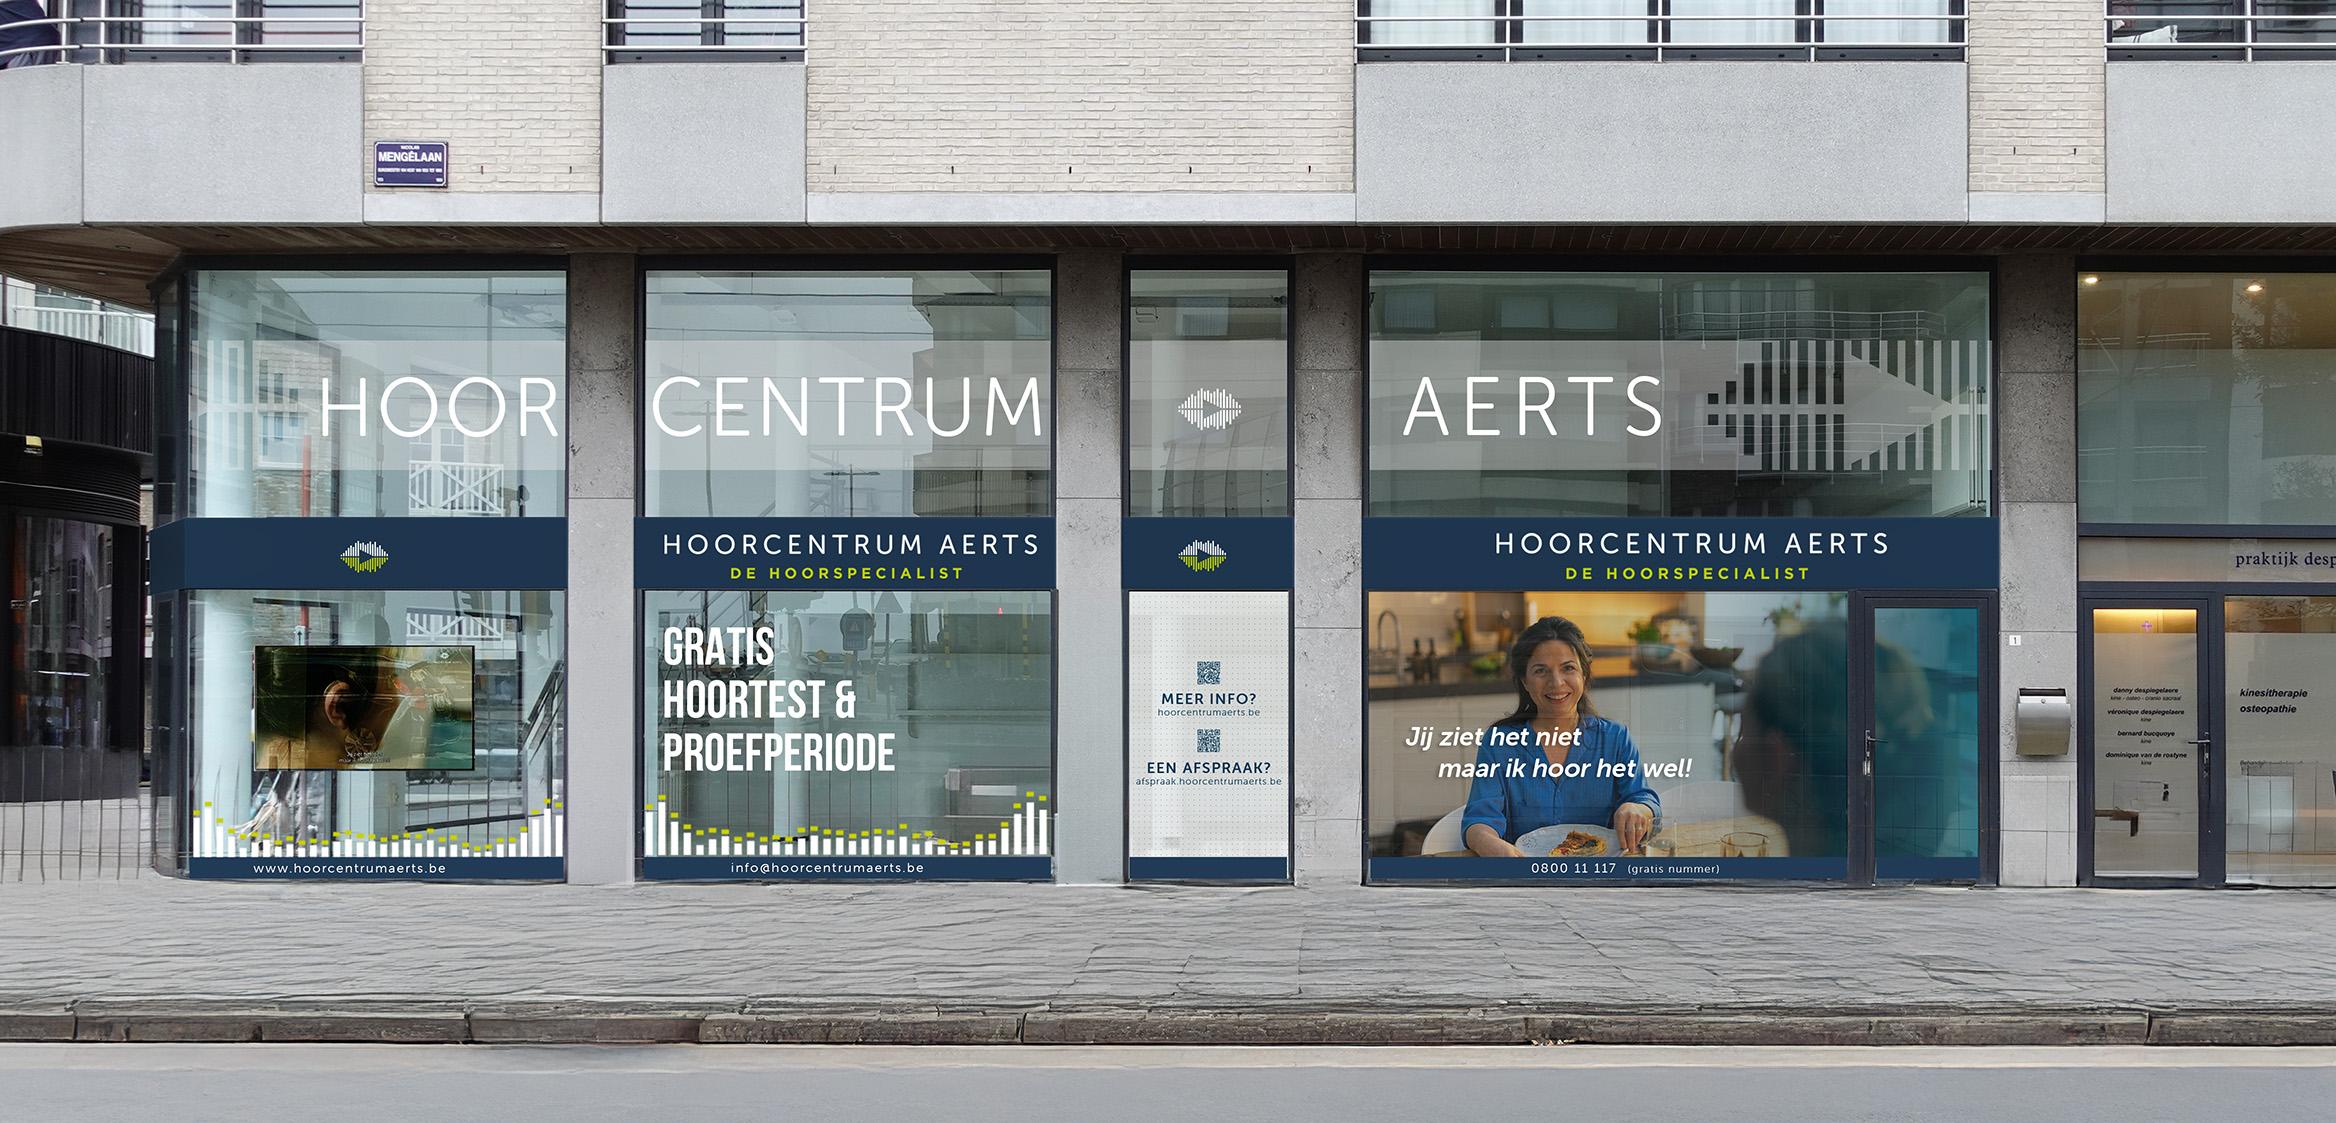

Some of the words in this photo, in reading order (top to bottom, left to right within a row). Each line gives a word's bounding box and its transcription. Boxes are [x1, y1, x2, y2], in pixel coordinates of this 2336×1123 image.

[319, 375, 560, 438] HOOR
[651, 375, 1043, 438] CENTRUM
[1402, 375, 1662, 437] AERTS
[664, 534, 921, 555] HOORCENTRUM
[939, 534, 1038, 555] AERTS
[1496, 532, 1765, 554] HOORCENTRUM
[1784, 532, 1888, 554] AERTS
[2235, 551, 2298, 568] praktijk
[730, 567, 756, 580] DE
[769, 567, 962, 580] HOORSPECIALIST
[1566, 567, 1592, 580] DE
[1606, 567, 1809, 580] HOORSPECIALIST
[664, 625, 777, 666] GRATIS
[2013, 637, 2017, 648] 1
[664, 679, 826, 719] HOORTEST
[835, 680, 856, 719] &
[1161, 692, 1204, 705] MEER
[1210, 693, 1257, 705] INFO?
[2239, 688, 2308, 700] kinesitherapie
[1157, 709, 1261, 718] hoorcentrumaerts.be
[2239, 704, 2297, 715] osteopathie
[1405, 726, 1434, 751] Jij
[1438, 726, 1484, 747] ziet
[1490, 726, 1530, 746] het
[1535, 726, 1582, 746] niet
[664, 732, 896, 772] PROEFPERIODE
[1147, 761, 1176, 774] EEN
[1182, 761, 1271, 774] AFSPRAAK?
[1438, 763, 1501, 778] maar
[1505, 758, 1527, 778] ik
[1532, 758, 1592, 778] hoor
[1596, 758, 1637, 778] het
[1643, 758, 1693, 778] wel!
[1135, 777, 1282, 787] afspraak.hoorcentrumaerts.be
[252, 862, 447, 875] www.hoorcentrumaerts.be
[731, 862, 924, 875] info@hoorcentrumaerts.be
[1531, 862, 1568, 874] 0800
[1574, 862, 1588, 874] 11
[1594, 862, 1616, 874] 117
[1627, 864, 1664, 876] (gratis
[1668, 864, 1720, 874] nummer)
